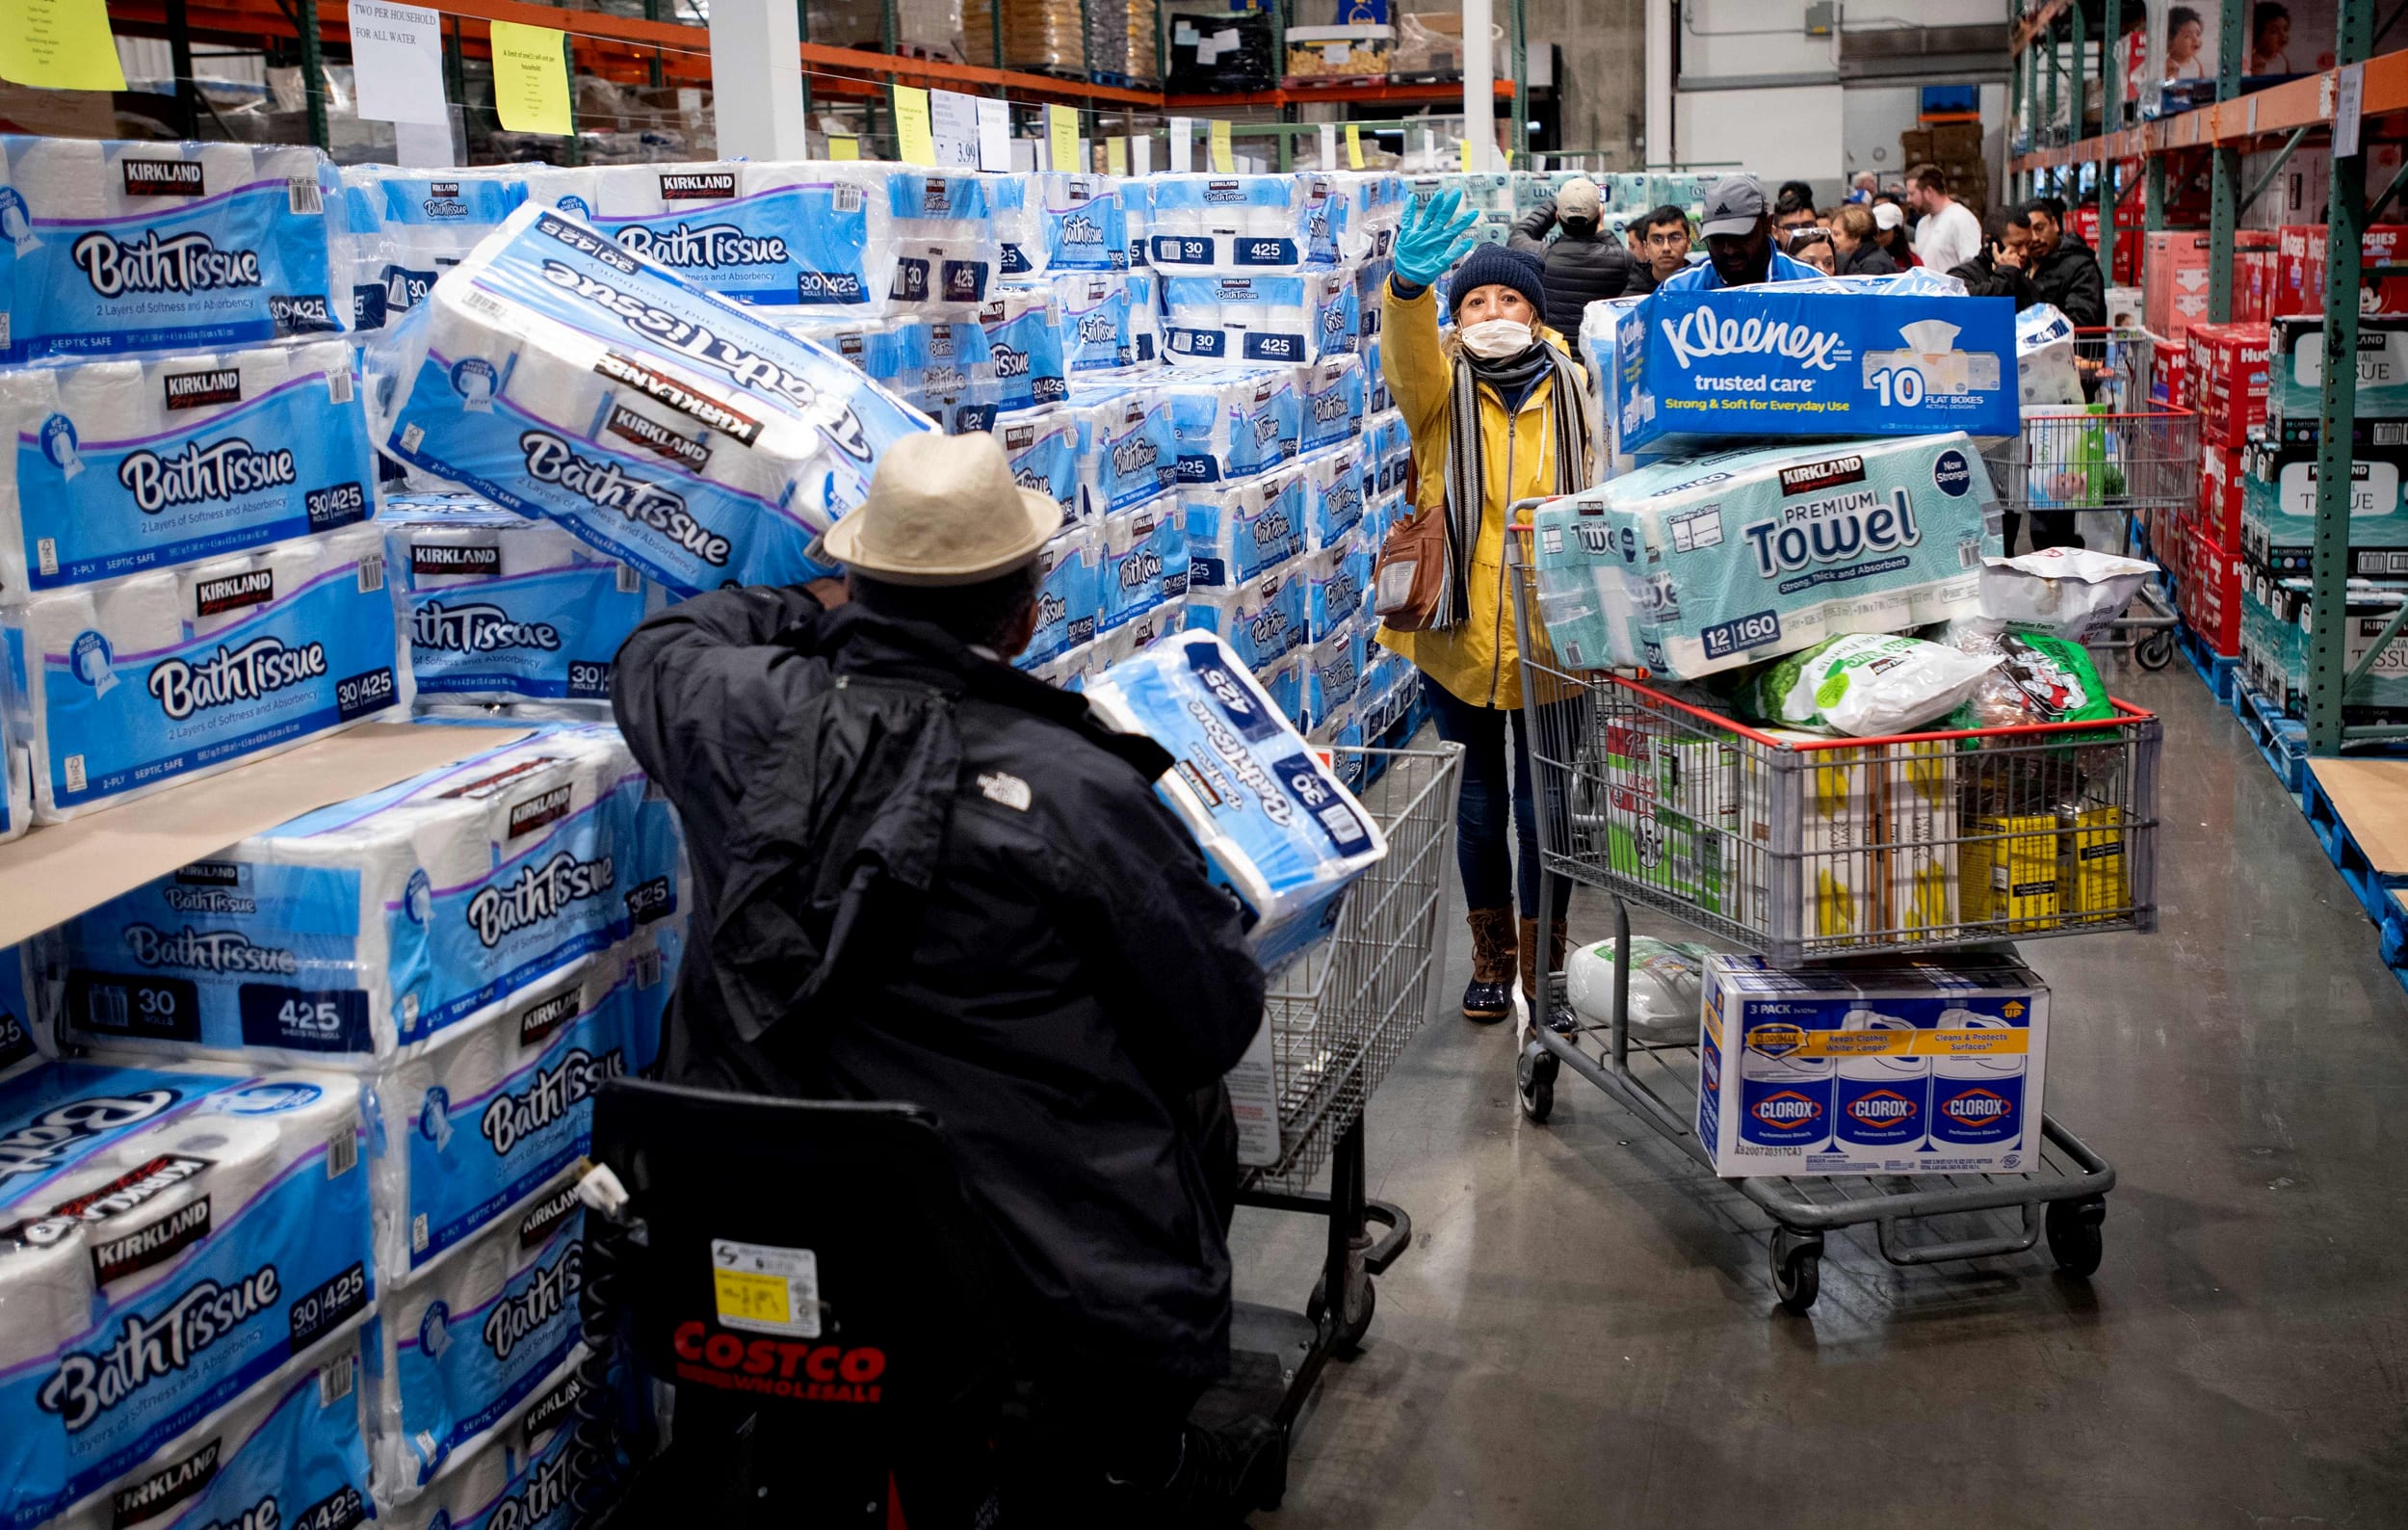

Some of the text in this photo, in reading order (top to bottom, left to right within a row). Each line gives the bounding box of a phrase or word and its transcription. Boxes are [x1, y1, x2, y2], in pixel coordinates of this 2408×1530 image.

[354, 4, 436, 26] TWO PER HOUSEHOLD
[355, 27, 416, 45] FOR ALL WATER
[127, 163, 201, 184] KIRKLAND
[663, 176, 734, 191] KIRKLAND
[1185, 242, 1281, 255] 30 425
[729, 271, 775, 282] Absorbency
[799, 275, 859, 292] 30 425
[908, 268, 974, 288] 30 425
[408, 280, 427, 297] 30
[96, 305, 103, 315] 2
[105, 304, 134, 317] Layers
[136, 303, 145, 313] of
[147, 302, 186, 313] Softness
[294, 300, 327, 319] 425
[50, 336, 112, 349] SEPTIC SAFE
[1195, 334, 1290, 353] 30 425
[1661, 304, 1838, 370] Kleenex
[169, 373, 238, 395] KIRKLAND
[1043, 379, 1064, 392] 425
[1694, 374, 1813, 393] trusted care
[1871, 365, 1924, 408] 10
[1664, 398, 1850, 414] Strong & Soft for Everyday Use
[1925, 395, 1984, 405] FLAT BOXES
[1622, 412, 1634, 436] 10
[615, 409, 707, 462] KIRKLAND
[1177, 461, 1206, 474] 425
[1783, 458, 1862, 485] KIRKLAND
[1944, 461, 1962, 472] Now
[309, 487, 361, 514] 30 425
[1785, 492, 1874, 523] PREMIUM
[141, 497, 287, 534] 2 Layers of Softness and Absorbency
[1745, 489, 1920, 574] Towel
[72, 552, 156, 575] 2-PLY SEPTIC SAFE
[415, 548, 497, 565] KIRKLAND
[1781, 558, 1908, 594] Strong, Thick and Absorbent
[200, 572, 272, 602] KIRKLAND
[1078, 620, 1093, 632] 425
[1706, 616, 1776, 647] 12 160
[1710, 645, 1732, 656] ROLLS
[571, 666, 598, 683] 30
[339, 686, 358, 704] 30
[361, 674, 391, 698] 425
[1202, 670, 1250, 714] 425
[169, 690, 318, 740] 2 Layers of Softness and Absorbency
[103, 757, 184, 789] 2-PLY SEPTIC SAFE
[1291, 774, 1323, 805] 30
[512, 787, 570, 824] KIRKLAND
[139, 989, 340, 1032] 30 425
[1749, 1004, 1791, 1015] 3 PACK
[2004, 1009, 2022, 1018] UP
[1856, 1034, 1888, 1042] Clothes
[1934, 1033, 1962, 1042] Cleans
[1973, 1033, 2008, 1042] Protects
[1760, 1101, 1813, 1119] CLOROX
[1855, 1100, 1908, 1118] CLOROX
[1950, 1099, 2002, 1117] CLOROX
[466, 1204, 491, 1226] SEPTIC
[523, 1185, 580, 1234] KIRKLAN
[97, 1204, 208, 1267] KIRKLAND
[293, 1271, 364, 1331] 30 425
[674, 1320, 886, 1384] COSTCO
[180, 1369, 199, 1389] and
[733, 1372, 881, 1403] WHOLESALE
